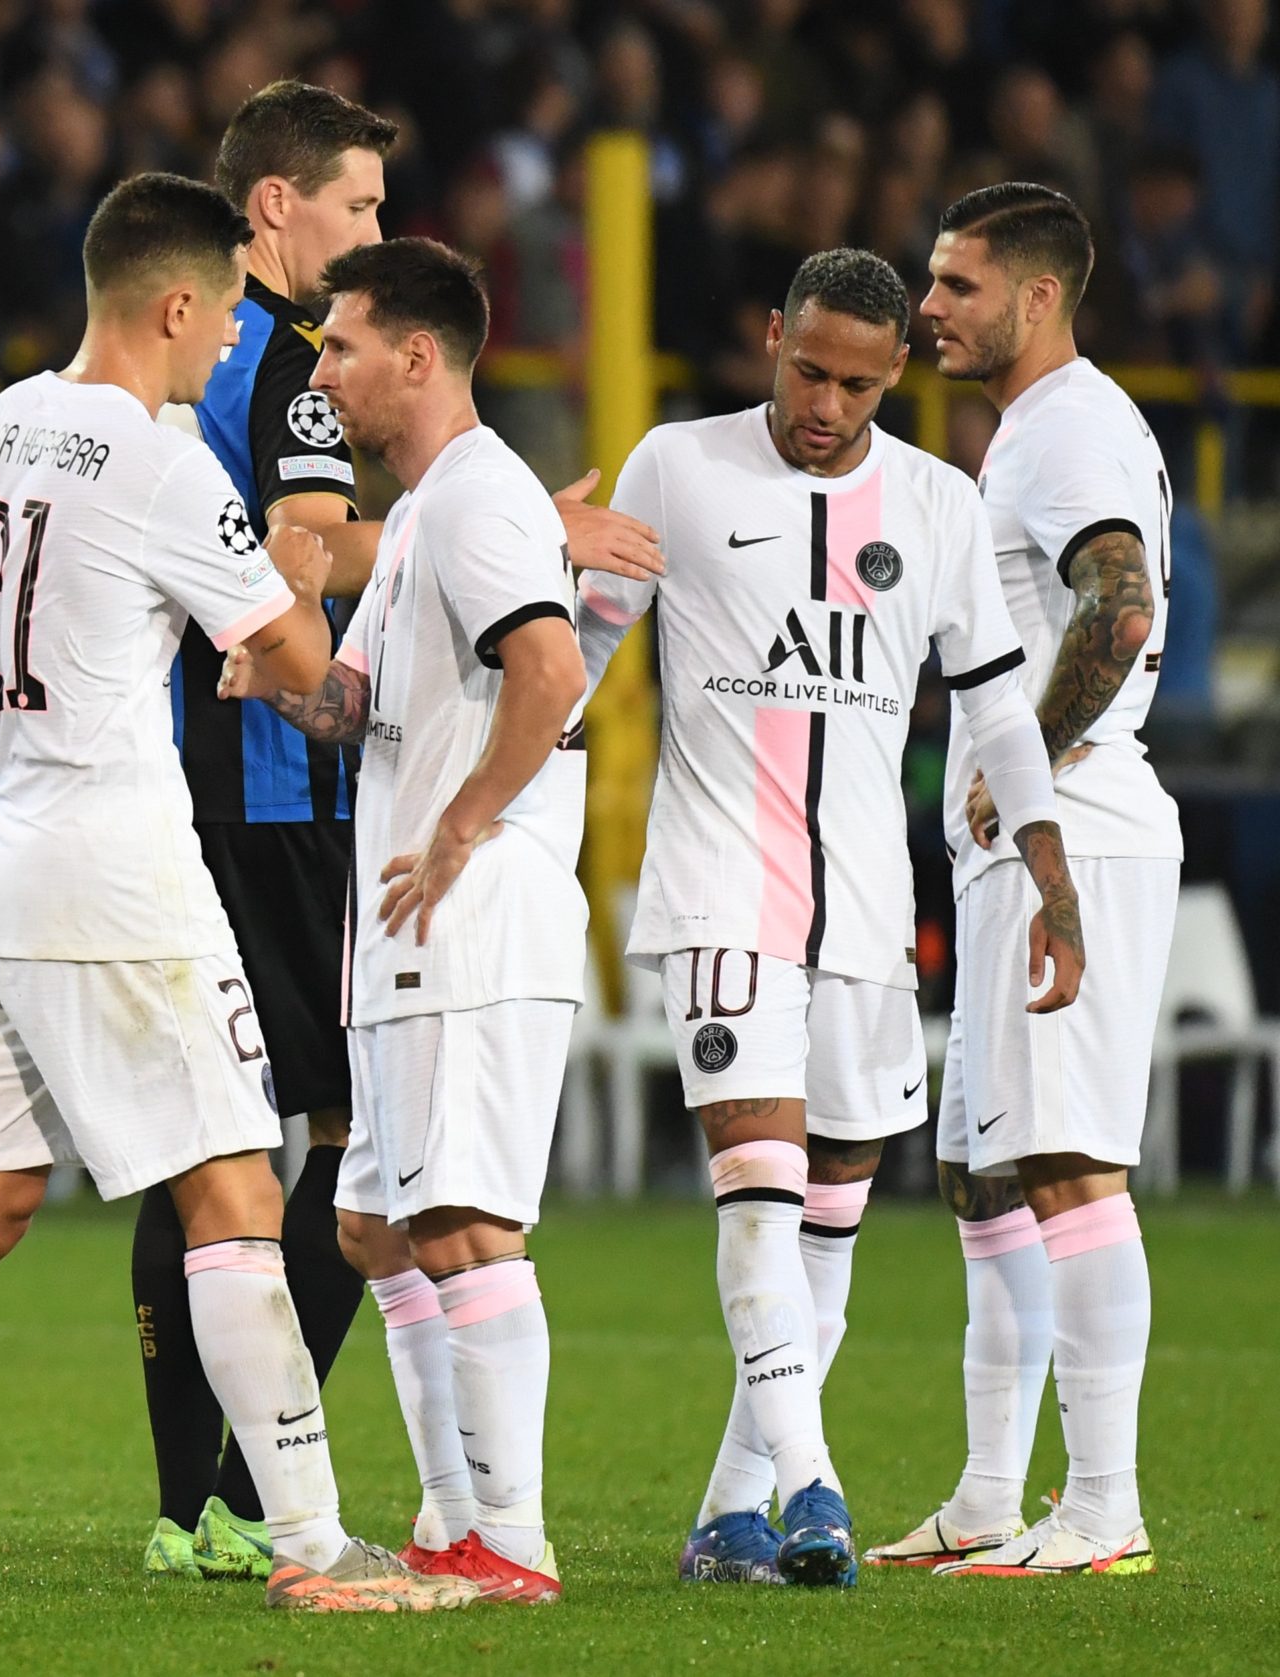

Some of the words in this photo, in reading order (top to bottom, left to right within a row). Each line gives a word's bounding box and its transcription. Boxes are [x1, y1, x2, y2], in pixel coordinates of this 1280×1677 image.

[865, 545, 895, 559] PARIS
[702, 675, 777, 698] ACCOR
[783, 683, 828, 701] LIVE
[684, 947, 759, 1021] 10
[747, 1364, 805, 1387] PARIS
[276, 1429, 328, 1450] PARIS
